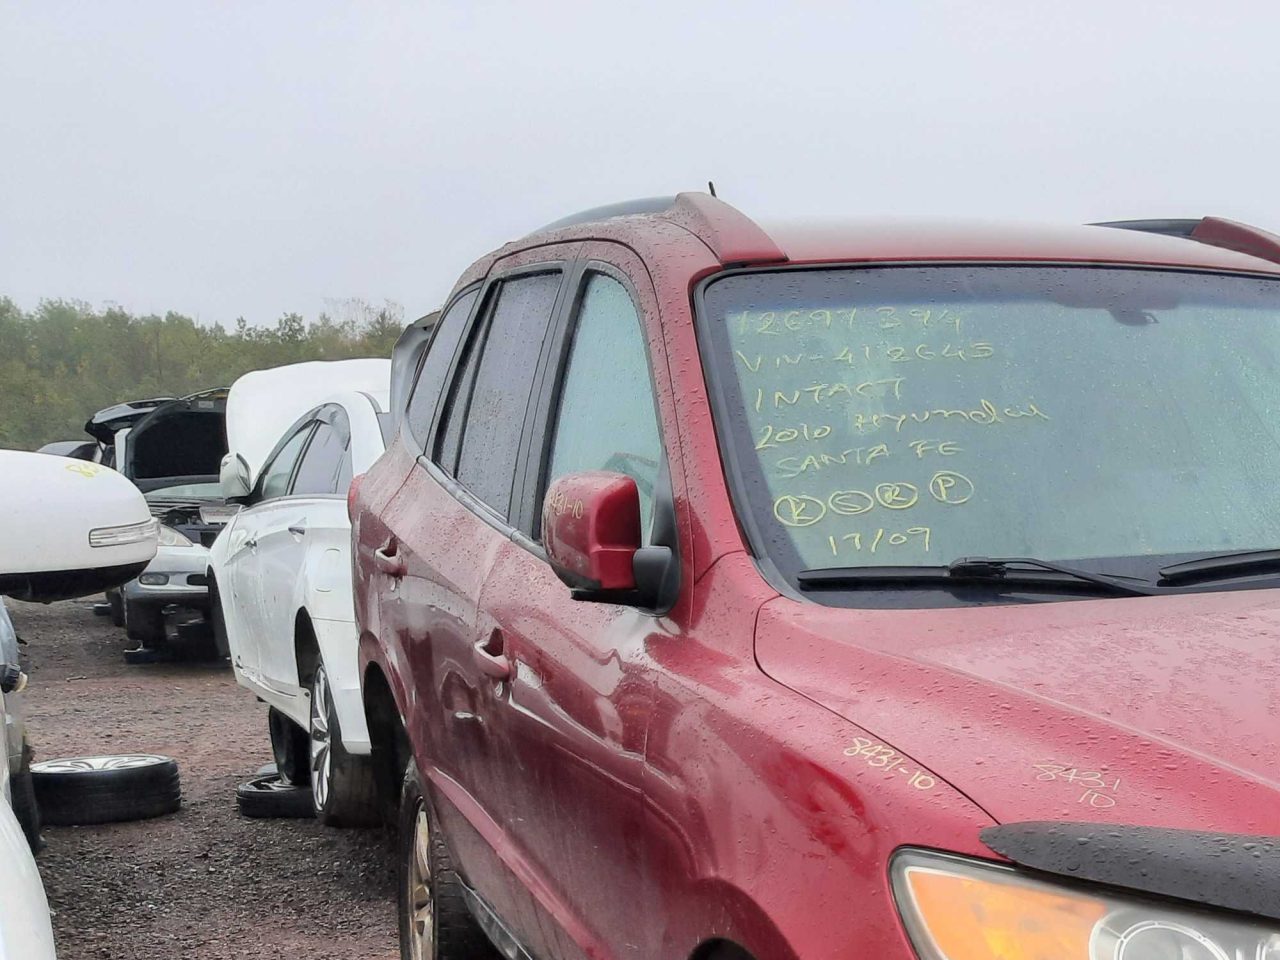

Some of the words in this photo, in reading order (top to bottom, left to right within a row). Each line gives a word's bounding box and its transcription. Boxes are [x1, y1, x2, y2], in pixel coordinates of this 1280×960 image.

[755, 377, 906, 412] INTACT
[774, 444, 891, 477] SANTA
[910, 439, 966, 458] FE
